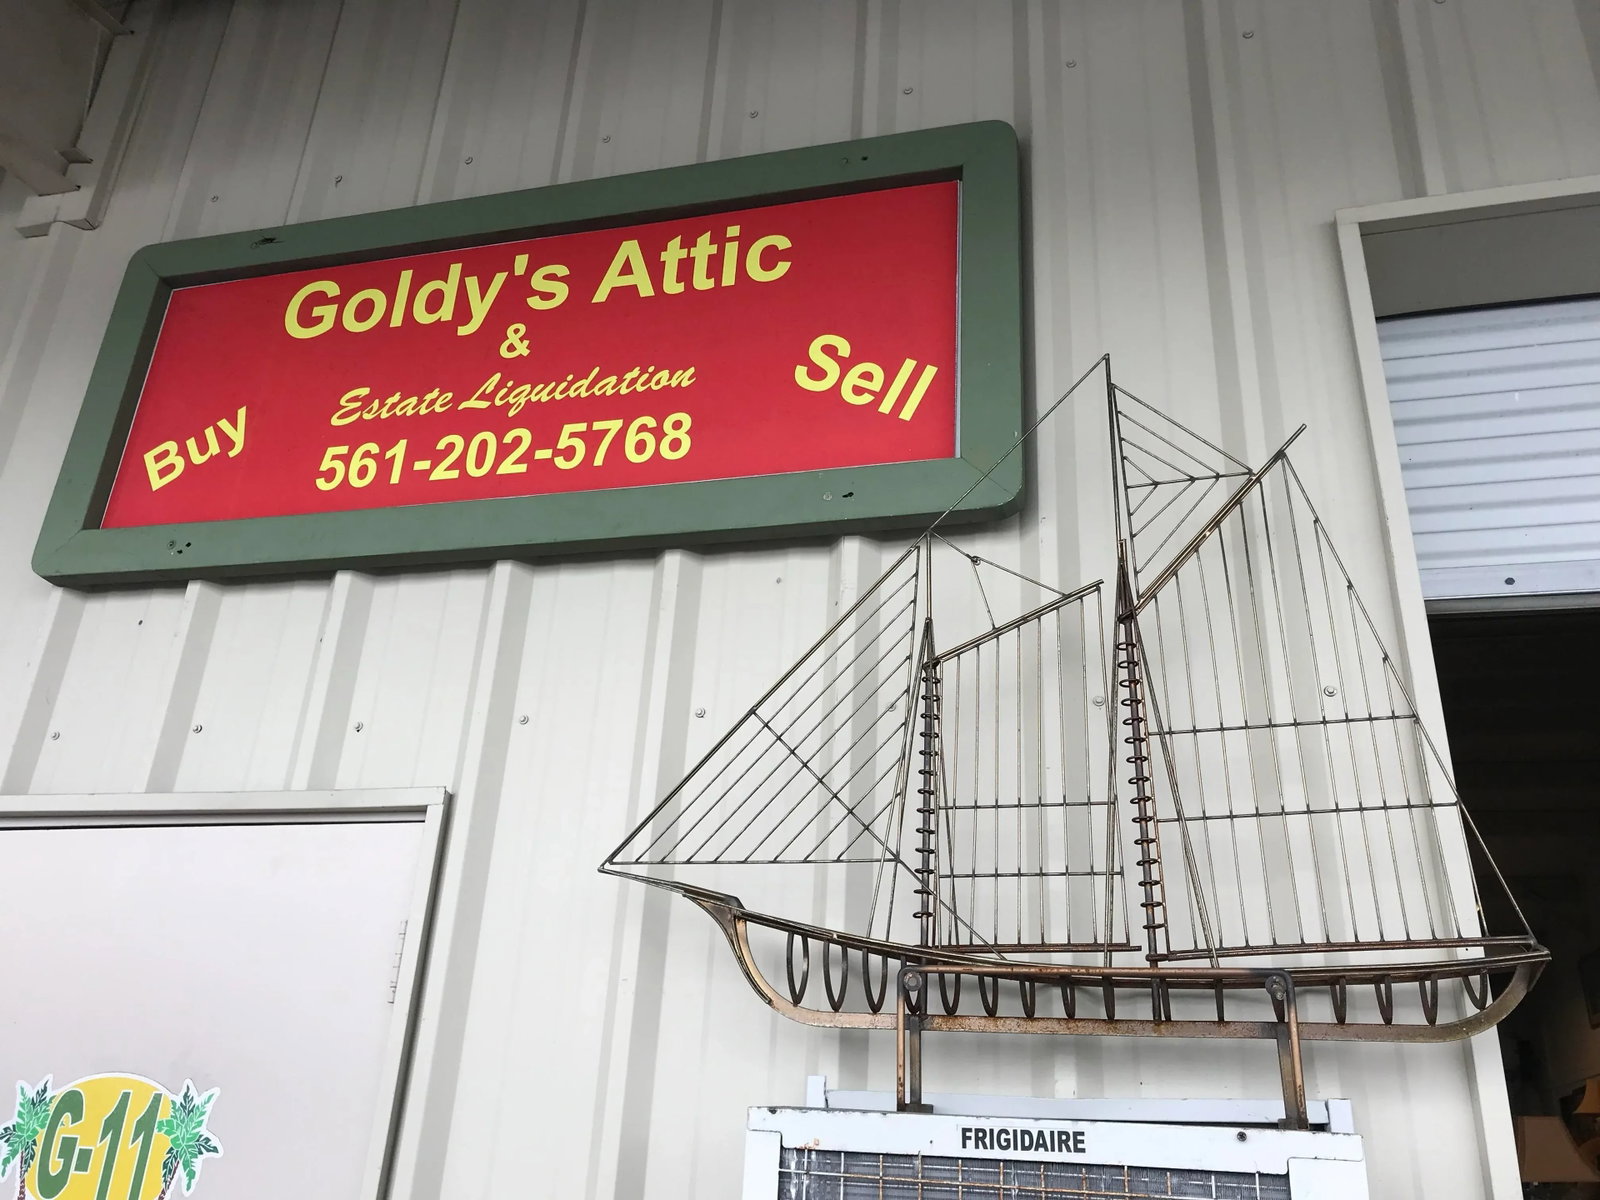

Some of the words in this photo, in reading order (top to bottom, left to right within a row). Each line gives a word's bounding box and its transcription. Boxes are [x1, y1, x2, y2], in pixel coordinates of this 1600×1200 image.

[284, 253, 570, 338] Goldy's
[591, 225, 792, 304] Attic
[499, 322, 531, 360] &
[794, 333, 939, 422] Sell
[330, 385, 454, 428] Estate
[458, 364, 697, 418] Liquidation
[143, 405, 248, 493] Buy
[314, 411, 693, 492] 561-202-5768
[35, 1087, 164, 1200] G-11
[960, 1127, 1086, 1153] FRIGIDAIRE
